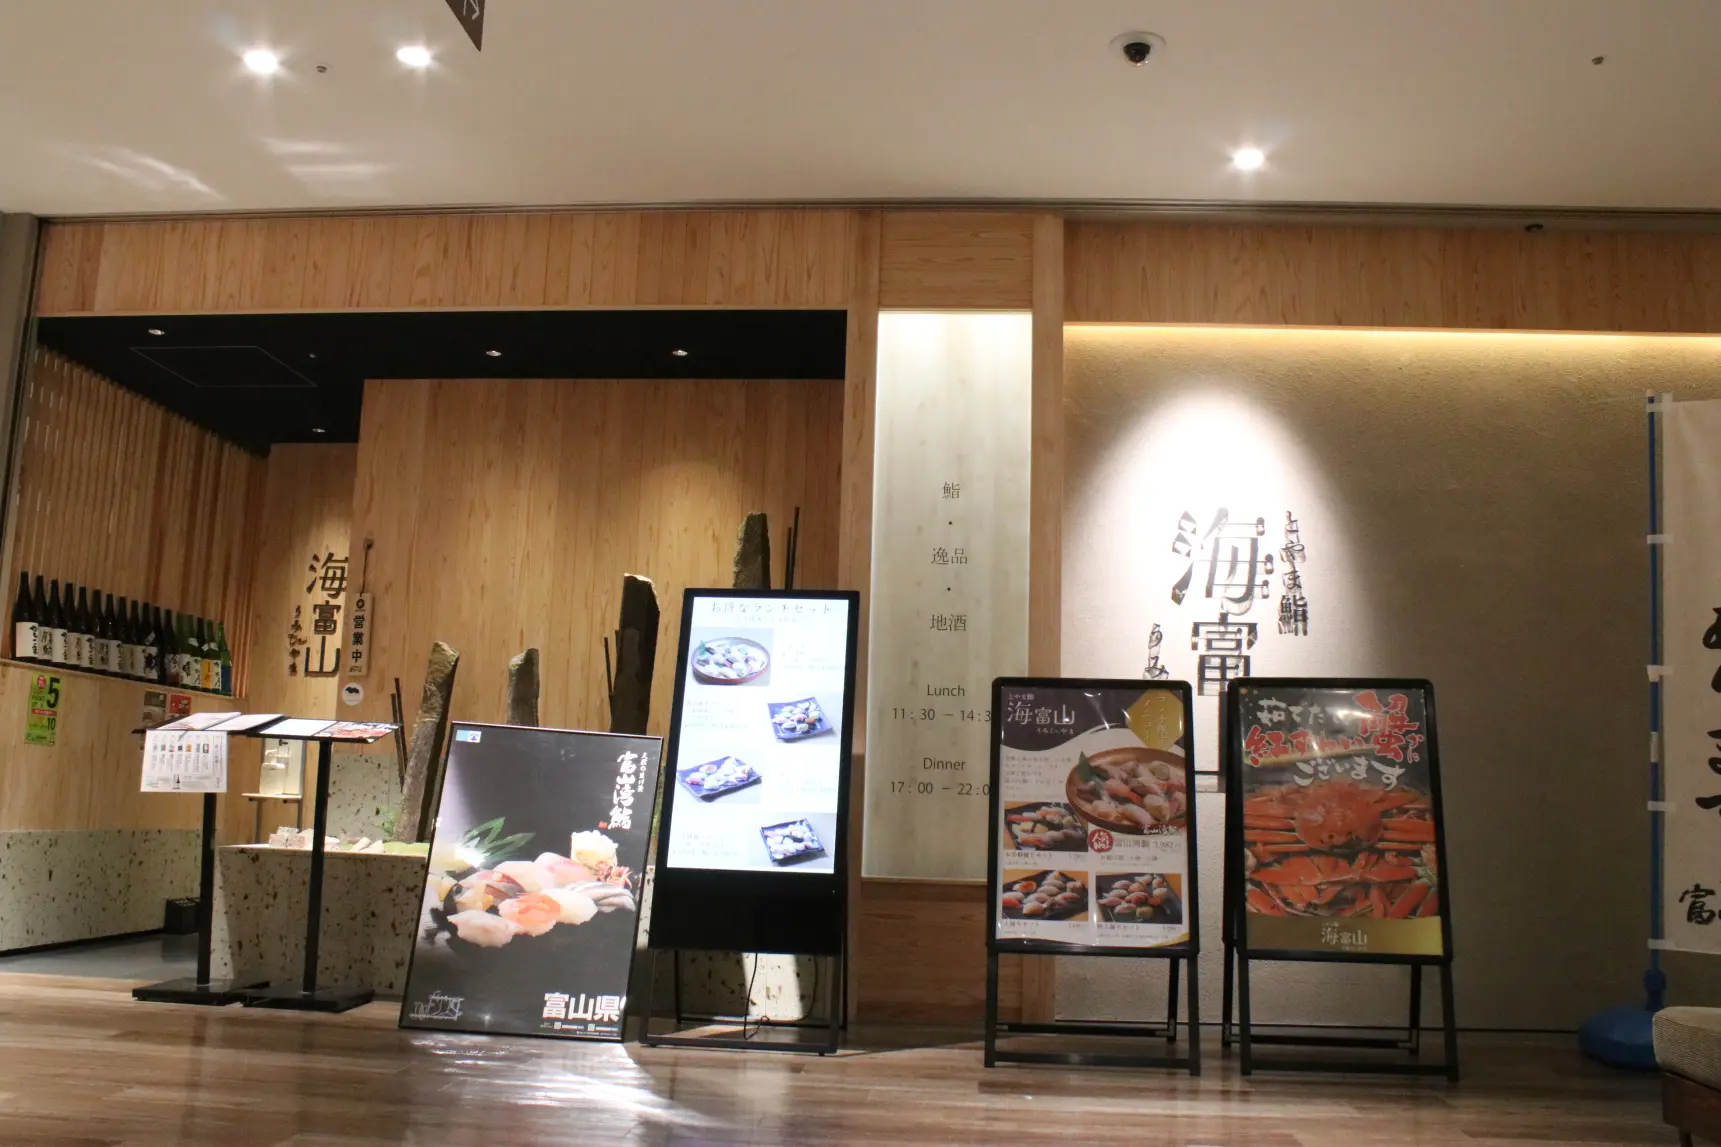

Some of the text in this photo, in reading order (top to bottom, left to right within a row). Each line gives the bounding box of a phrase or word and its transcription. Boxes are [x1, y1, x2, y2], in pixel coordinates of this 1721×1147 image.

[942, 482, 961, 499] 鮨
[931, 547, 968, 565] 逸品
[304, 552, 348, 677] 海富山
[929, 614, 967, 632] 地酒
[352, 614, 365, 663] 営業中
[46, 677, 61, 709] 5
[926, 684, 965, 697] Lunch
[959, 710, 991, 722] 14:3
[1007, 701, 1076, 726] 海富山
[923, 757, 966, 770] Dinner
[1293, 756, 1406, 791] ございます
[609, 750, 639, 830] 富山湾鮨
[957, 783, 991, 796] 22:0
[1678, 883, 1721, 926] 富
[542, 992, 621, 1022] 富山県
